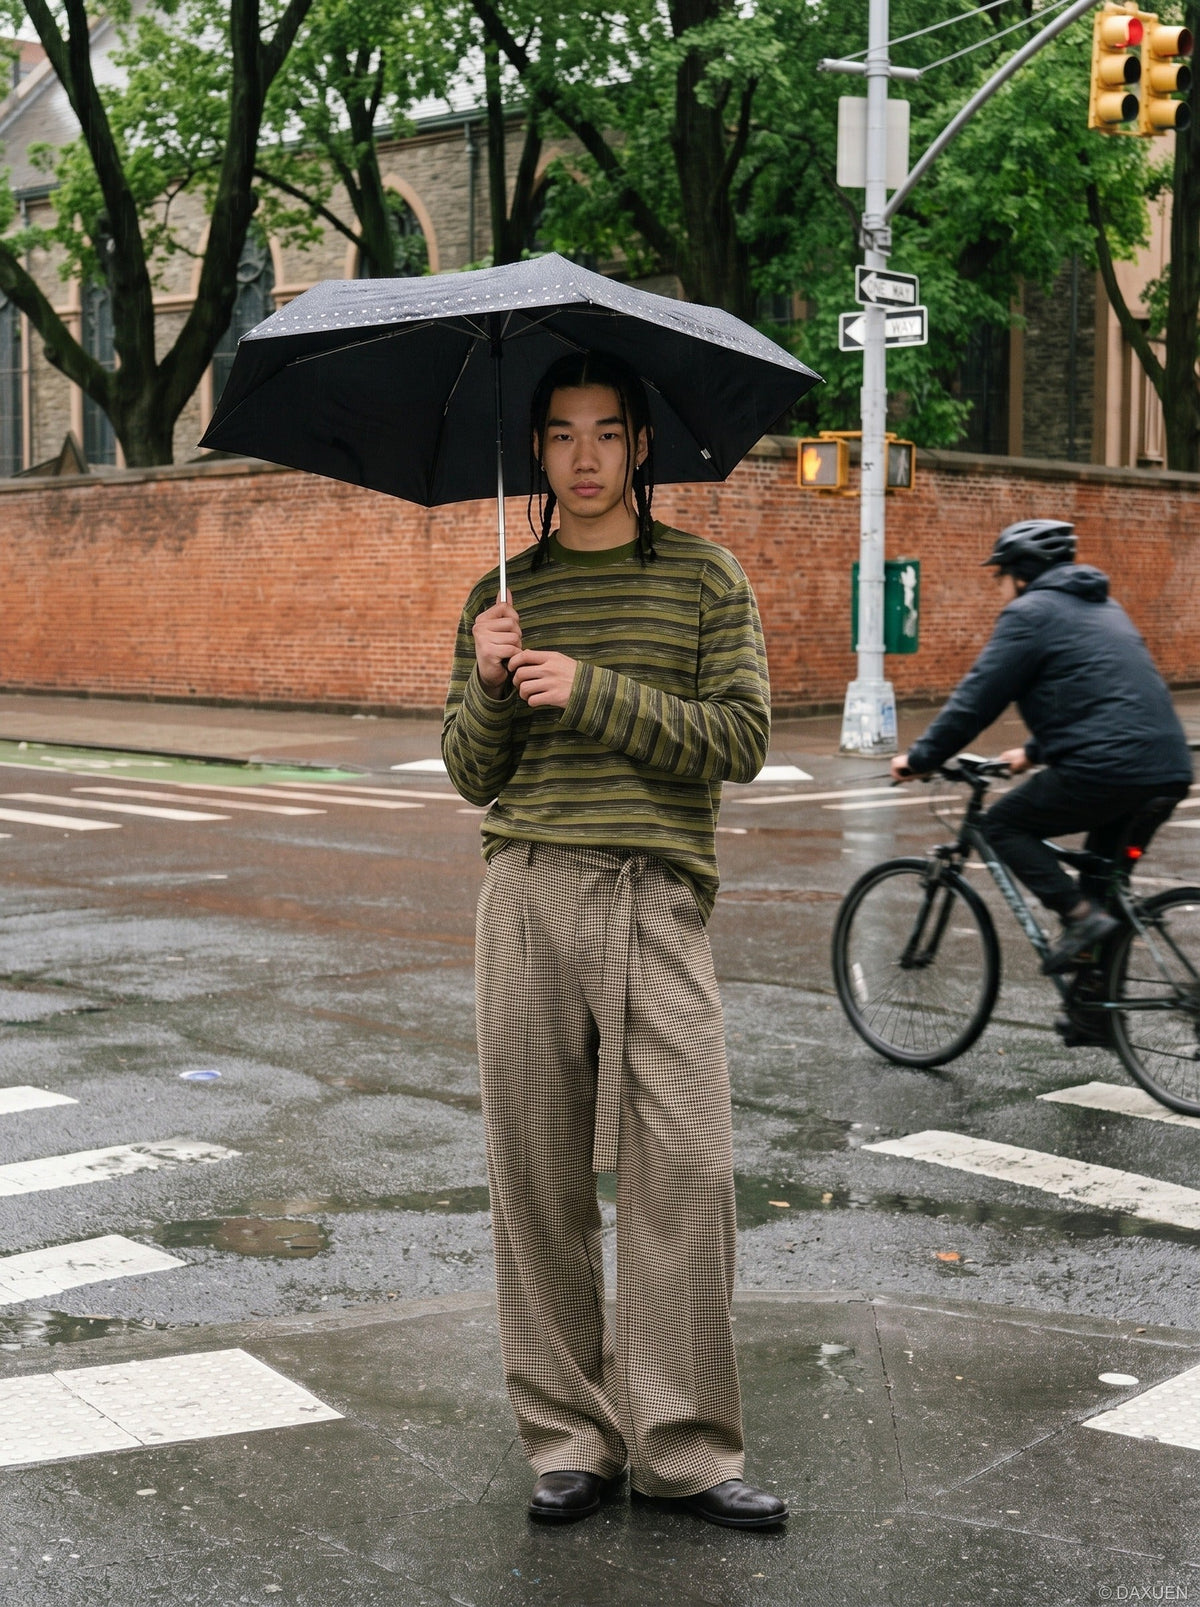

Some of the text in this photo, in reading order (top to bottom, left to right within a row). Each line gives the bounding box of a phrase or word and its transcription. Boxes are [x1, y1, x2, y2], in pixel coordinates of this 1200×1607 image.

[867, 280, 911, 297] ONE WAY
[891, 320, 915, 334] WAY
